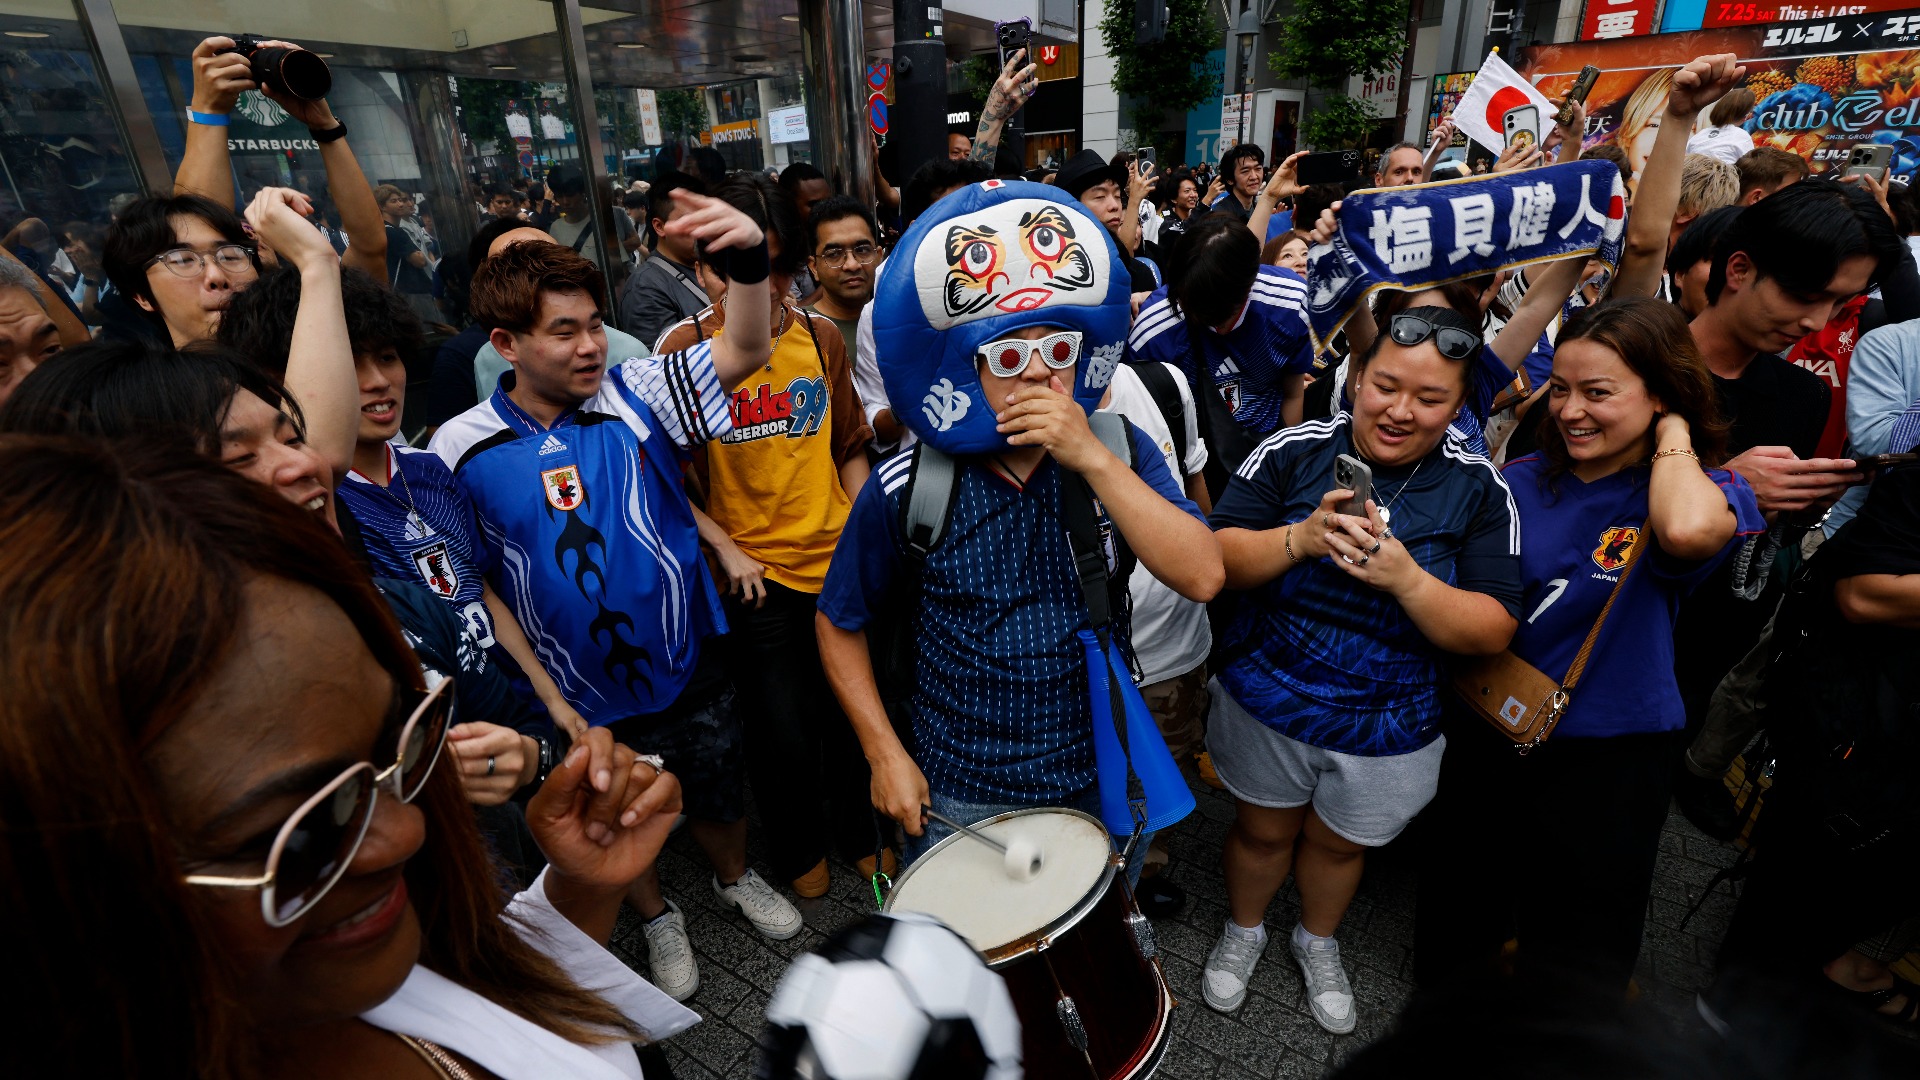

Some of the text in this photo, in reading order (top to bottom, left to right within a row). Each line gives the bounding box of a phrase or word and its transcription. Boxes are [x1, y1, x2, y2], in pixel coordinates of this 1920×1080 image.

[1717, 4, 1757, 21] 7.25
[1757, 11, 1775, 20] SAT
[1779, 5, 1808, 20] This
[1812, 5, 1824, 19] is
[1763, 23, 1842, 47] エルコレ
[1362, 74, 1396, 98] MAG
[1757, 97, 1920, 130] club el
[228, 139, 320, 150] STARBUCKS
[1813, 149, 1850, 161] エルコ
[1369, 173, 1608, 275] 塩貝健人
[730, 376, 829, 438] Kicks 99
[922, 378, 972, 432] 必
[539, 444, 568, 456] adidas
[1591, 573, 1618, 583] JAPAN
[1527, 578, 1569, 625] 7
